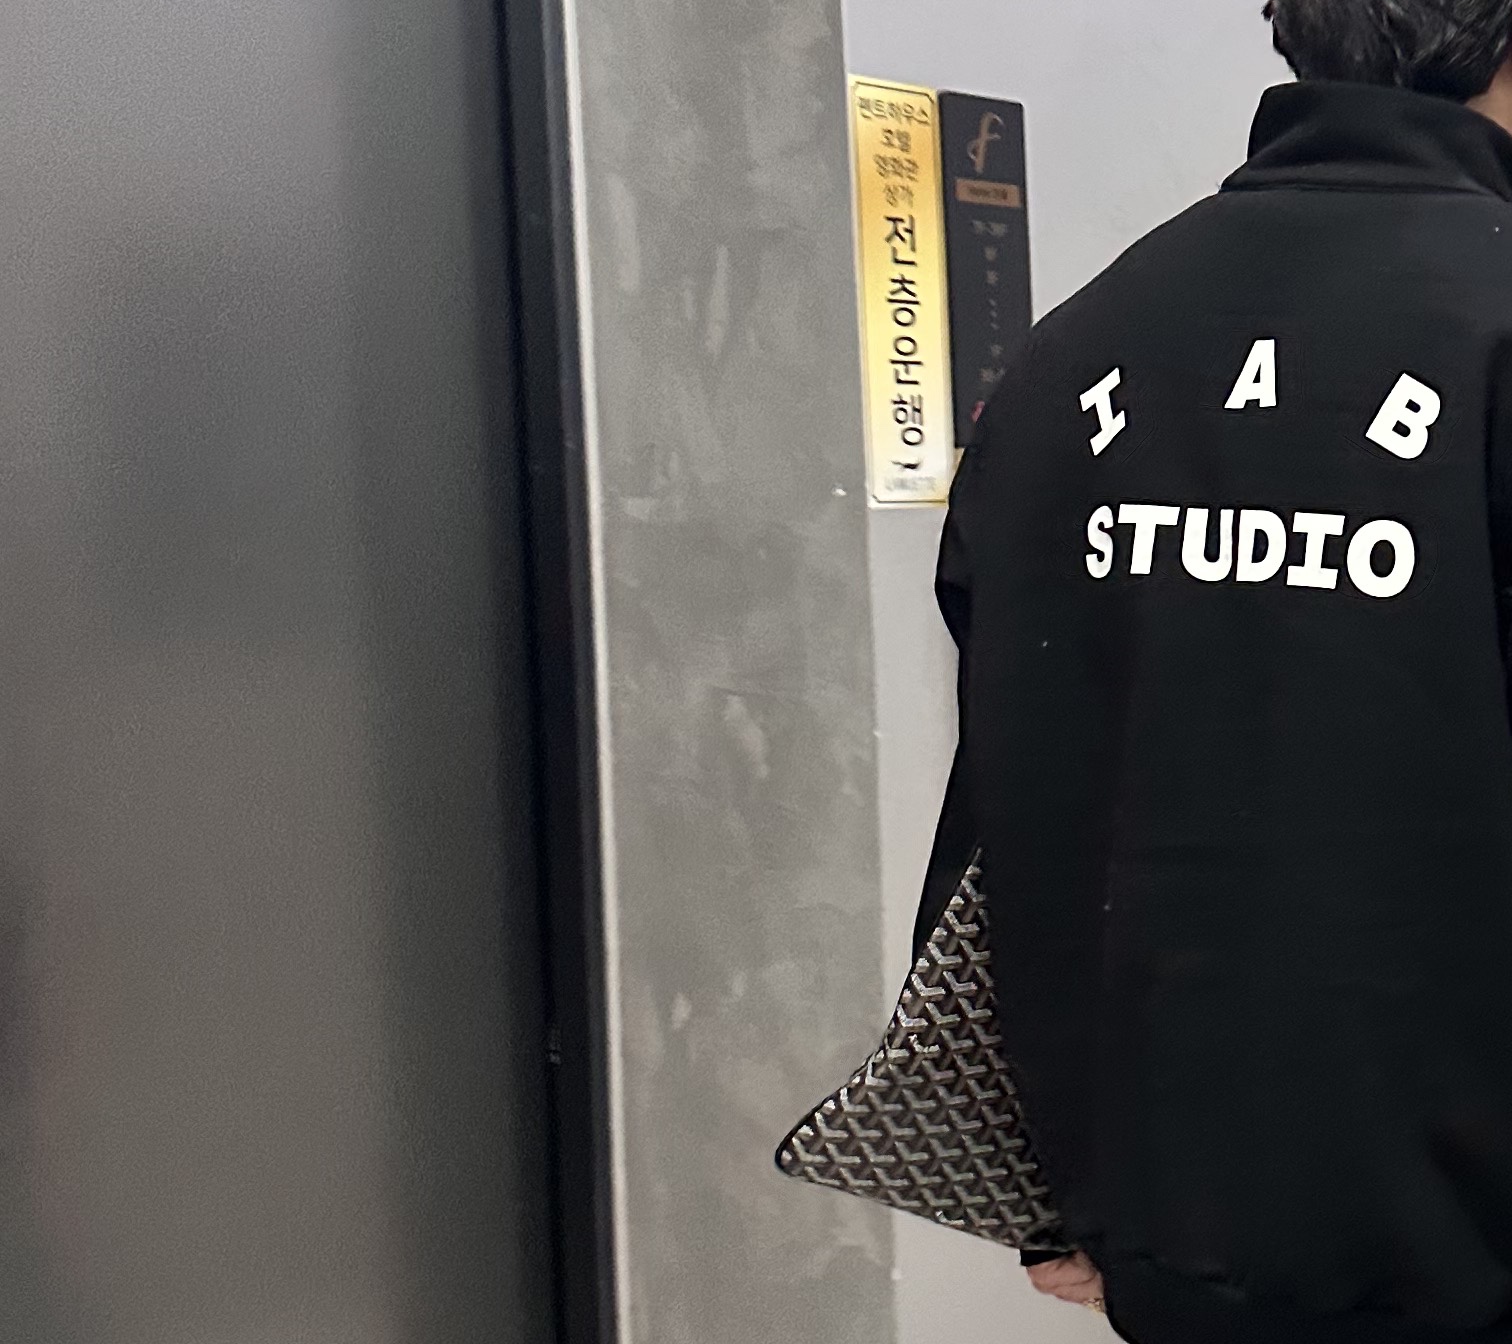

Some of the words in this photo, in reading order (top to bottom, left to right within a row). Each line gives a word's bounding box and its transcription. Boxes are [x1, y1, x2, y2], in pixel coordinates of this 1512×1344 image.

[858, 95, 930, 126] 펜트하우스
[883, 213, 926, 447] 전층운행
[1085, 503, 1416, 599] STUDIO
